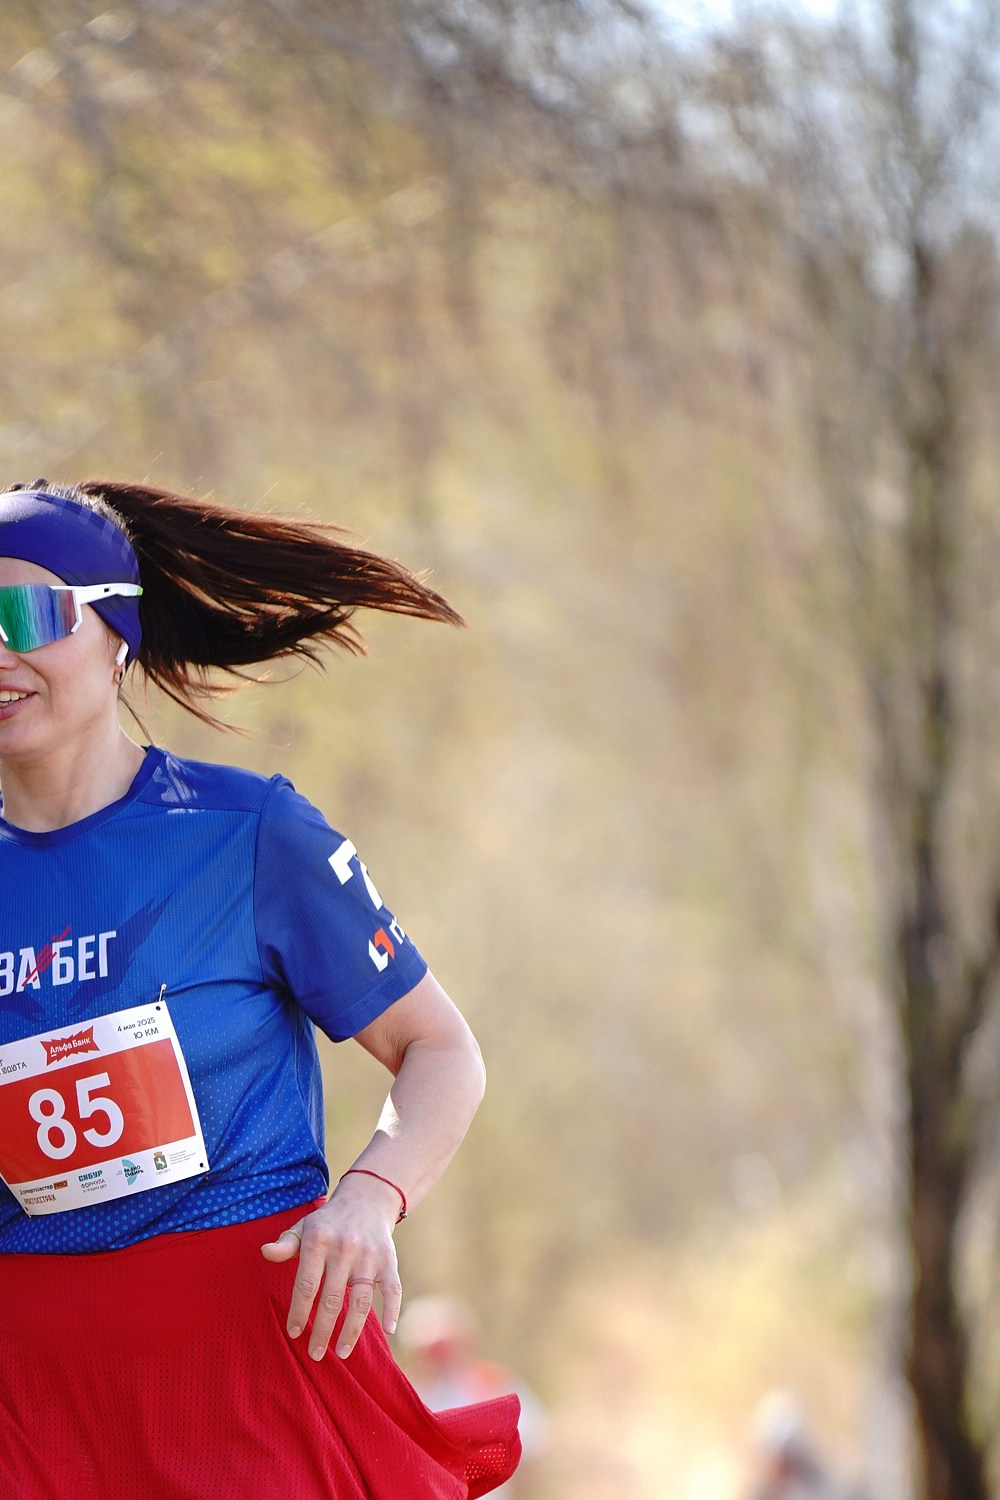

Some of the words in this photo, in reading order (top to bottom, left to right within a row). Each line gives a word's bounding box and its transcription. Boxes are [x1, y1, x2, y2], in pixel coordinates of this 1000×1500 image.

[123, 1024, 136, 1032] мая
[137, 1016, 156, 1028] 2025
[144, 1027, 159, 1036] КМ
[50, 1041, 73, 1057] Альфа
[72, 1037, 91, 1049] Банк
[28, 1071, 125, 1161] 85
[78, 1169, 103, 1182] СИБУР
